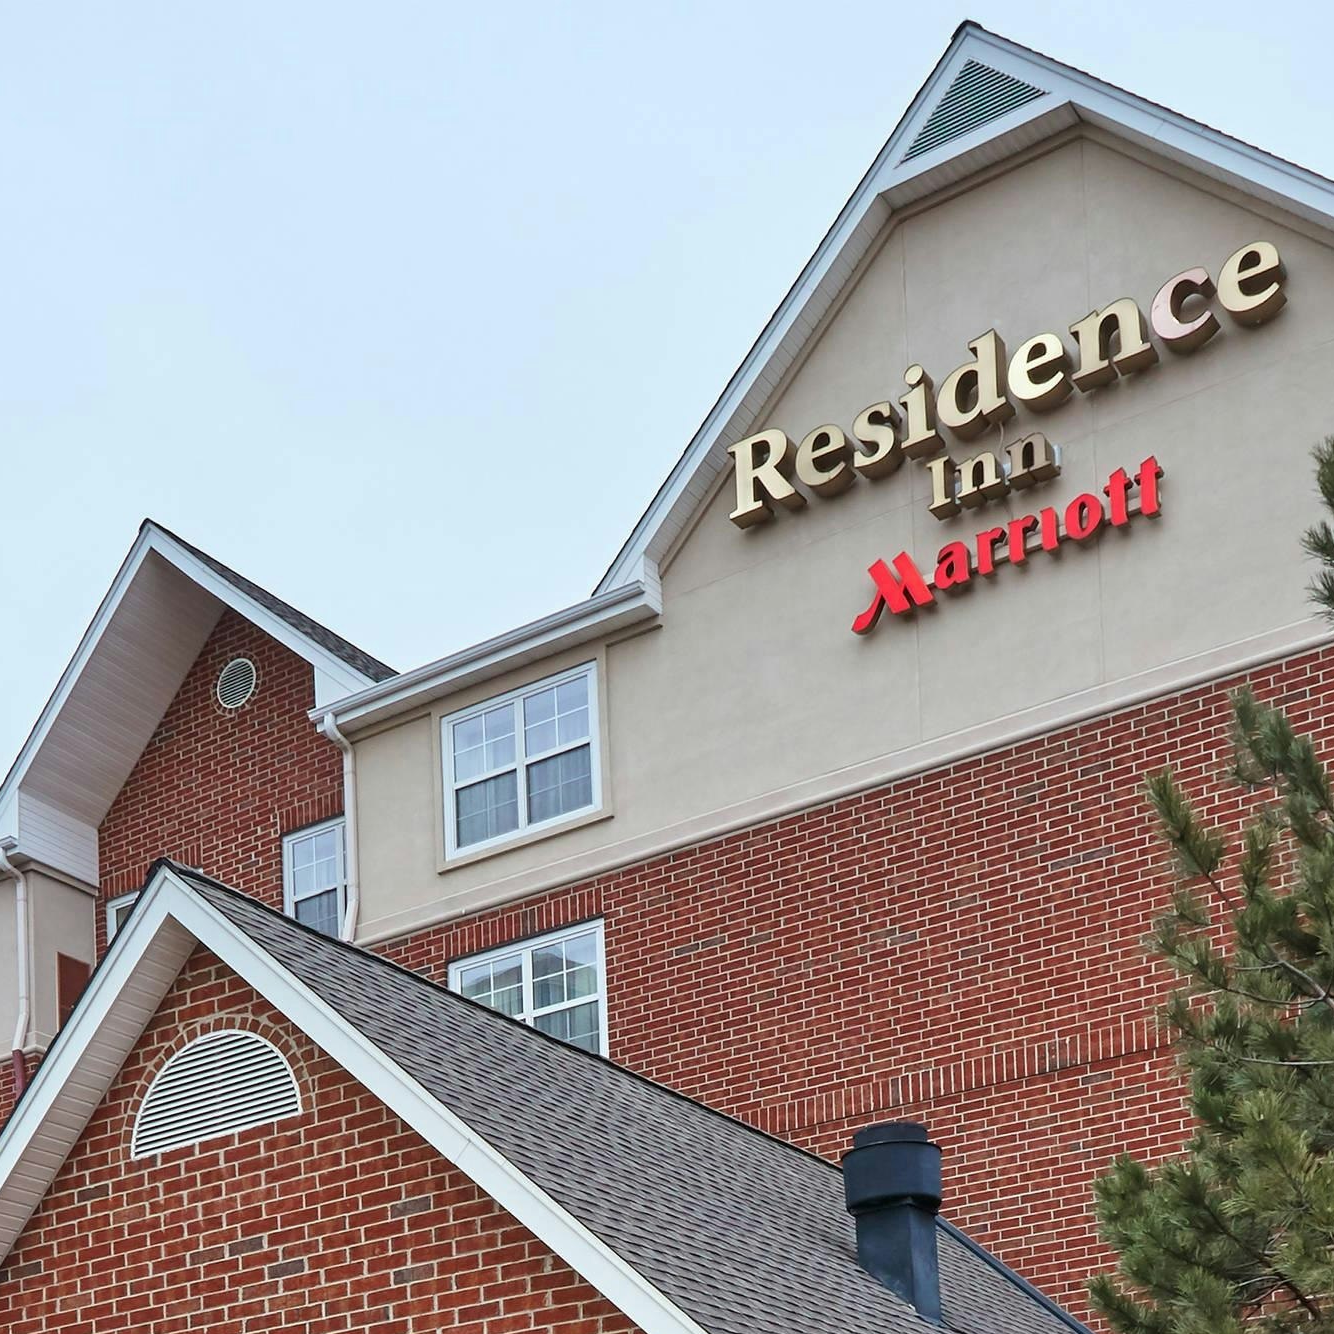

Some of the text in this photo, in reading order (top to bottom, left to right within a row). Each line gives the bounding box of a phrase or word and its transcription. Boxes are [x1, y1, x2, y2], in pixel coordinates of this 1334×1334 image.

[727, 240, 1286, 528] Residence
[851, 455, 1164, 635] Marriott
[926, 431, 1061, 519] Inn
